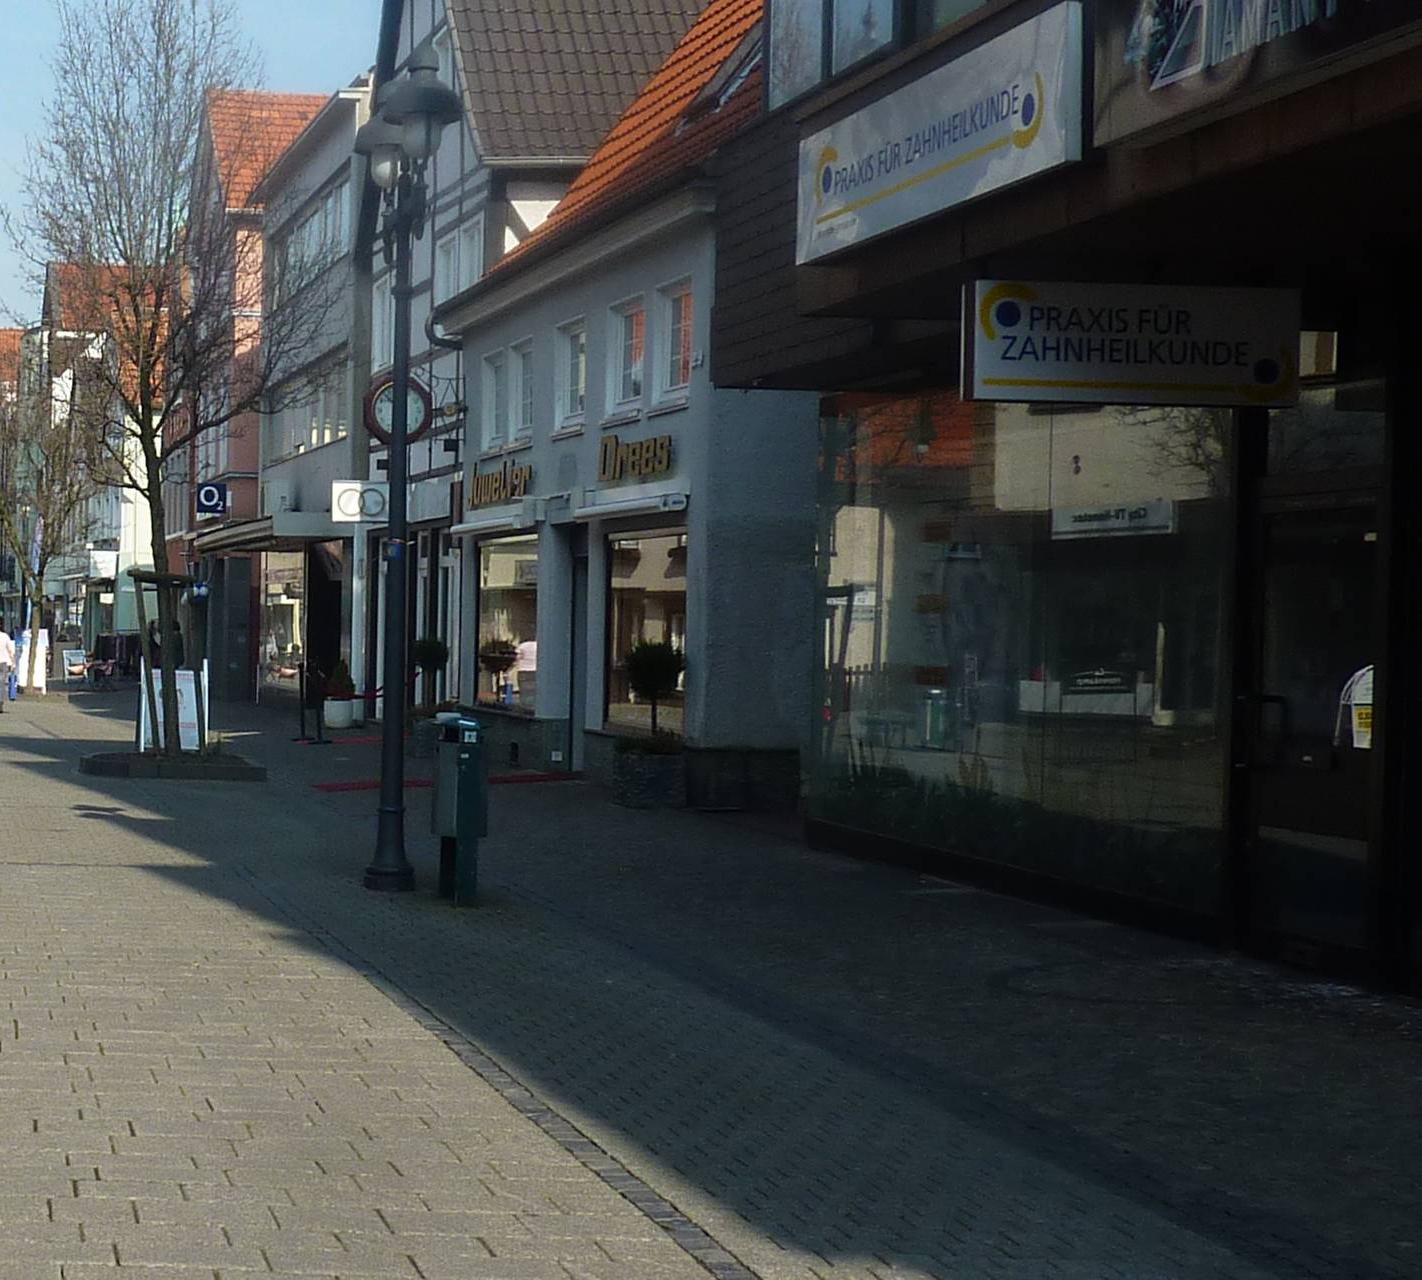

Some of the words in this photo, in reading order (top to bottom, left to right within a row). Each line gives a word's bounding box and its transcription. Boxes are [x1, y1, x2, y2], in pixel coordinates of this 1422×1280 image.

[833, 154, 874, 197] PRAXIS
[876, 142, 902, 178] FÜR
[904, 84, 1021, 166] ZAHNHEILKUNDE
[1028, 305, 1129, 334] PRAXIS
[1137, 302, 1192, 336] FÜR
[1000, 334, 1252, 367] ZAHNHEILKUNDE
[599, 434, 672, 482] Drees
